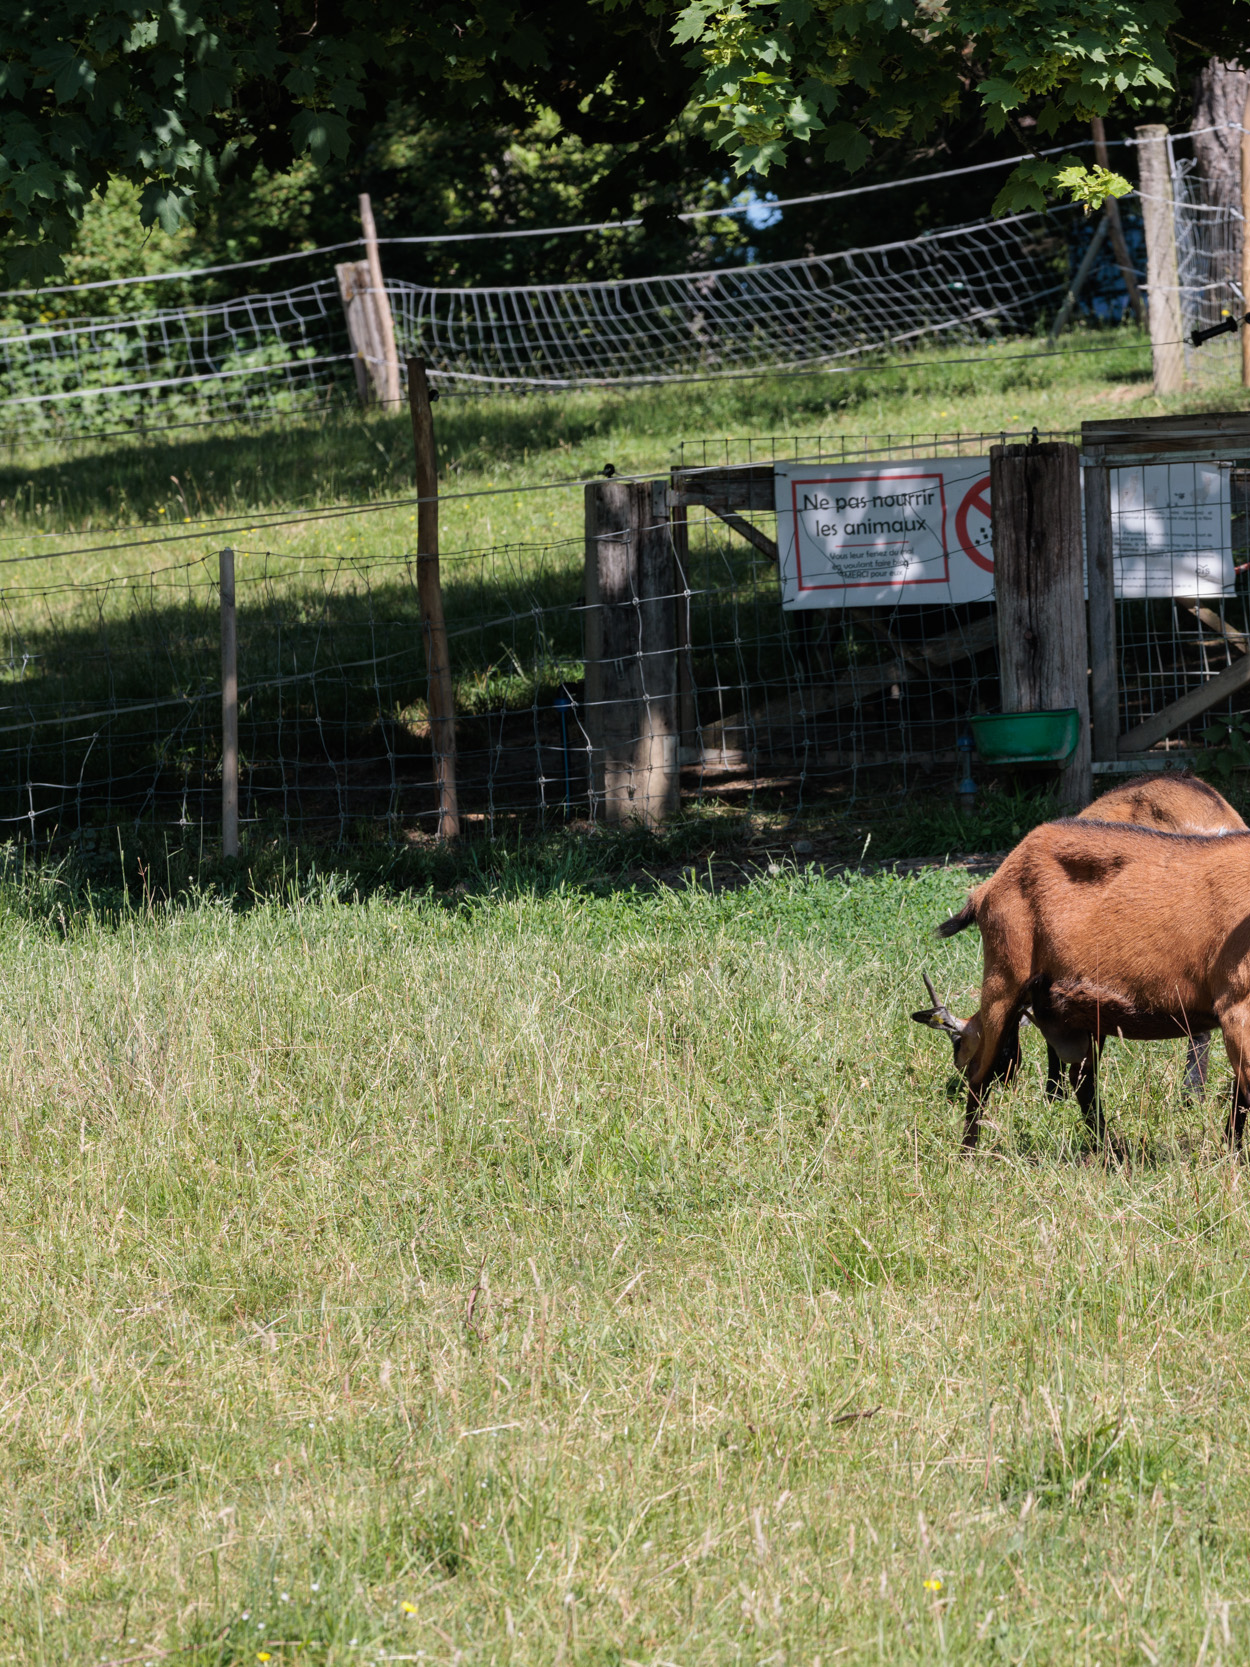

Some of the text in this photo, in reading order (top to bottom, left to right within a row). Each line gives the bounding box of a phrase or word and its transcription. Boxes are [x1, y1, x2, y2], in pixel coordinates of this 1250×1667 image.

[803, 491, 934, 513] Ne pas nourrir
[816, 517, 927, 537] les animaux
[829, 552, 848, 560] Vous
[849, 551, 864, 559] leur
[889, 549, 899, 557] du
[843, 561, 873, 570] voulant
[875, 559, 891, 568] faire
[870, 571, 887, 579] pour
